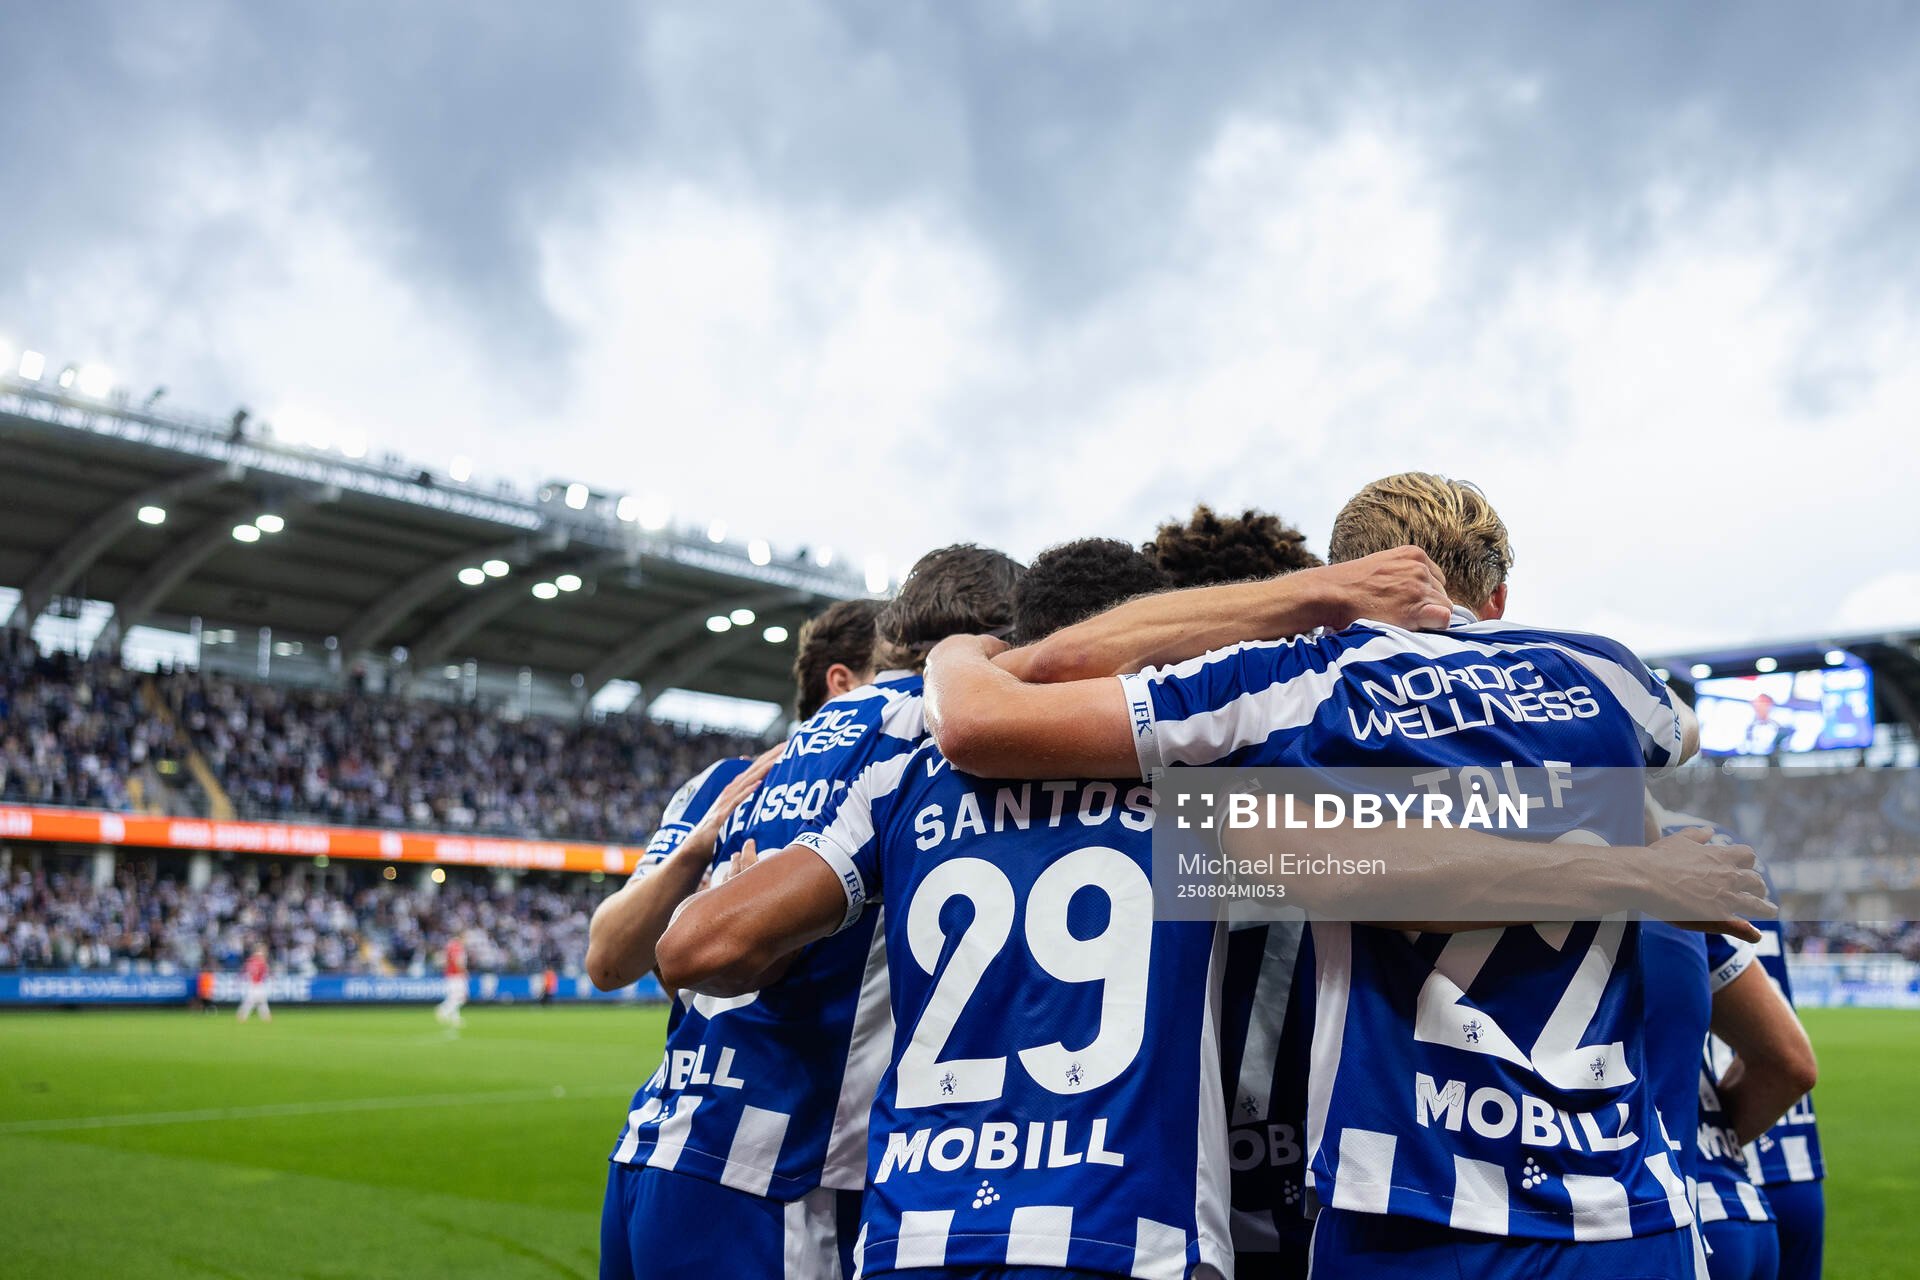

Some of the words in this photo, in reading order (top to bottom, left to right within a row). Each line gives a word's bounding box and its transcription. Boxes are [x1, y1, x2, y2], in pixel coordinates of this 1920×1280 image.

[1361, 660, 1544, 707] NORDIC
[1132, 701, 1153, 738] IFK
[1347, 686, 1601, 741] WELLNESS
[914, 781, 1161, 851] SANTOS
[844, 870, 865, 907] IFK
[895, 846, 1155, 1109] 29
[1717, 959, 1743, 983] IFK
[874, 1118, 1125, 1184] MOBILL
